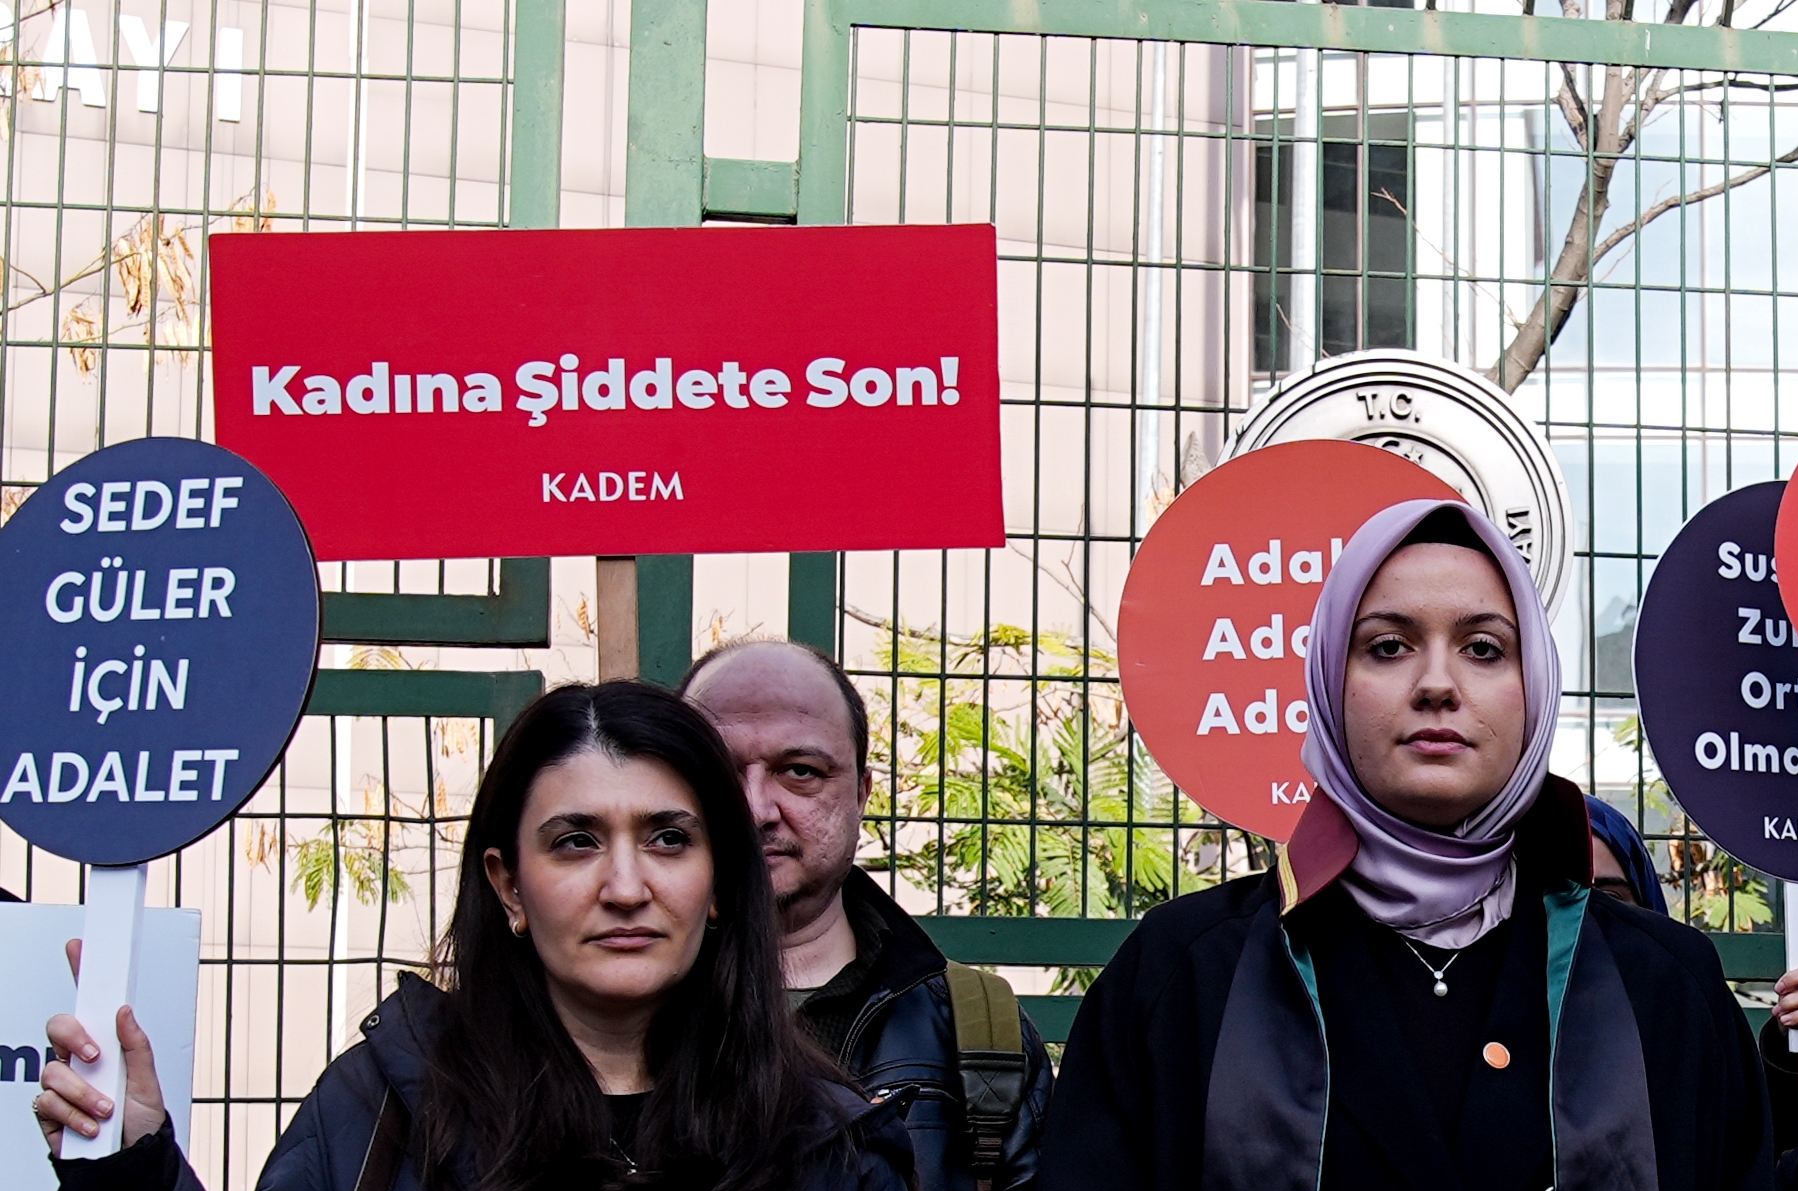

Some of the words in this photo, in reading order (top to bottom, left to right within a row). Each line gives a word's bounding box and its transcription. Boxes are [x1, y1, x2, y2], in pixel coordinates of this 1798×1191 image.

[0, 3, 244, 122] AYI
[252, 362, 502, 415] Kadına
[516, 354, 791, 427] Şiddete
[806, 357, 959, 407] Son!
[1356, 389, 1421, 422] T.C.
[60, 476, 243, 533] SEDEF
[543, 472, 683, 502] KADEM
[46, 557, 235, 622] GÜLER
[70, 645, 188, 724] İÇİN
[1, 750, 239, 804] ADALET
[1271, 782, 1317, 804] KA
